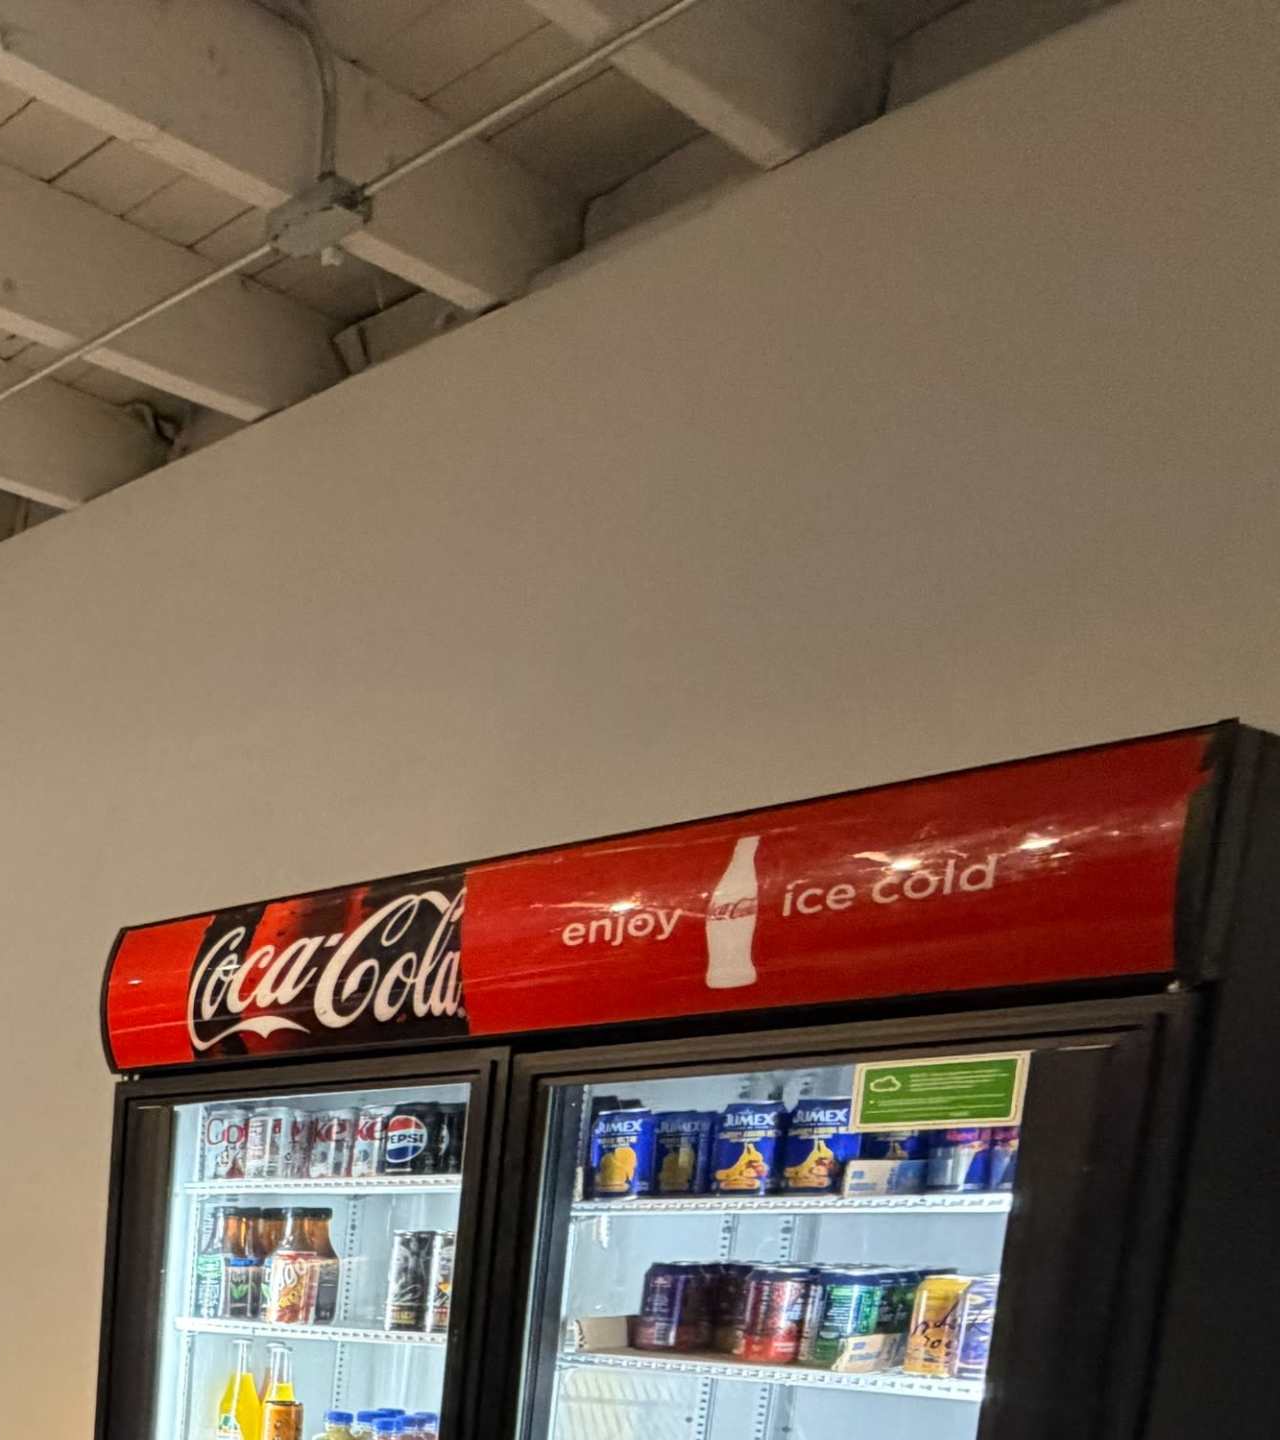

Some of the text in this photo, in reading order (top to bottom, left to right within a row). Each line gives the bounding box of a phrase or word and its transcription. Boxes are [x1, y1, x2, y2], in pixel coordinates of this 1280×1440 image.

[562, 907, 682, 947] enjoy
[781, 880, 856, 917] ice
[871, 855, 998, 905] cold
[188, 887, 468, 1050] Coca-Cola
[723, 1111, 777, 1128] JUMEX
[792, 1108, 849, 1124] JUMEX
[594, 1118, 643, 1135] JUMEX
